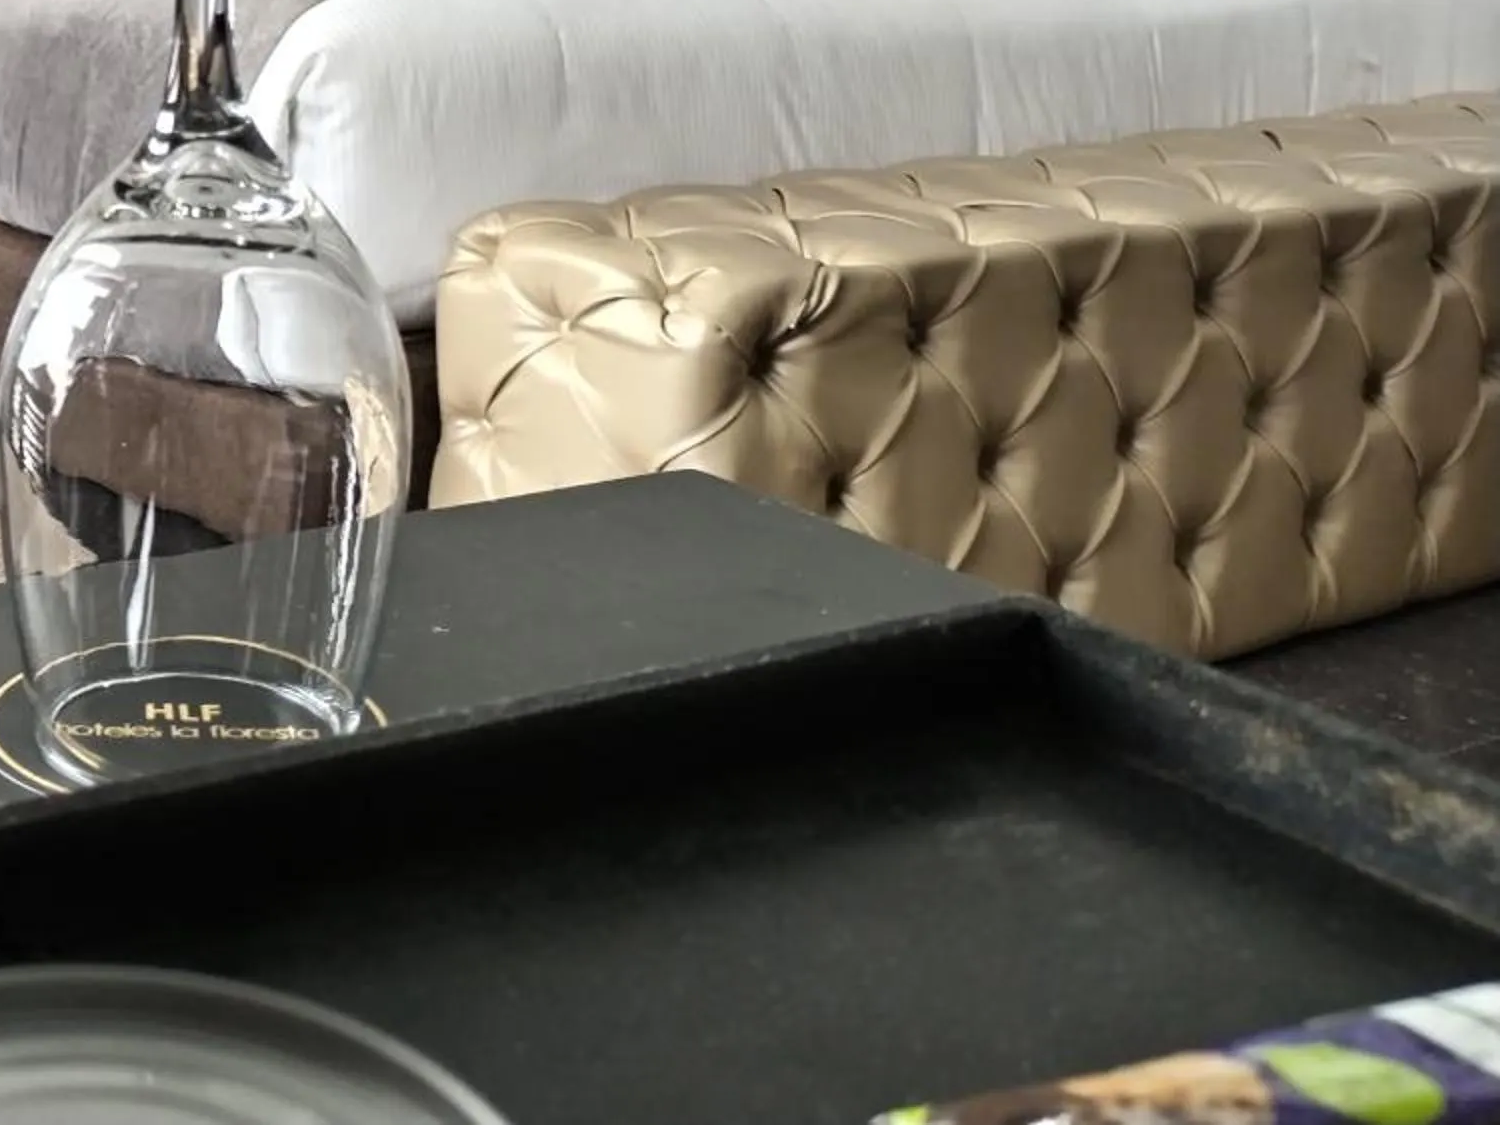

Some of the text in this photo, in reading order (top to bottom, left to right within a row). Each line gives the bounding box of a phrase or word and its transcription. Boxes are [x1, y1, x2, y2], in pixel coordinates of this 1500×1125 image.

[144, 702, 222, 722] HLF
[54, 721, 321, 742] hoteles la floresta
